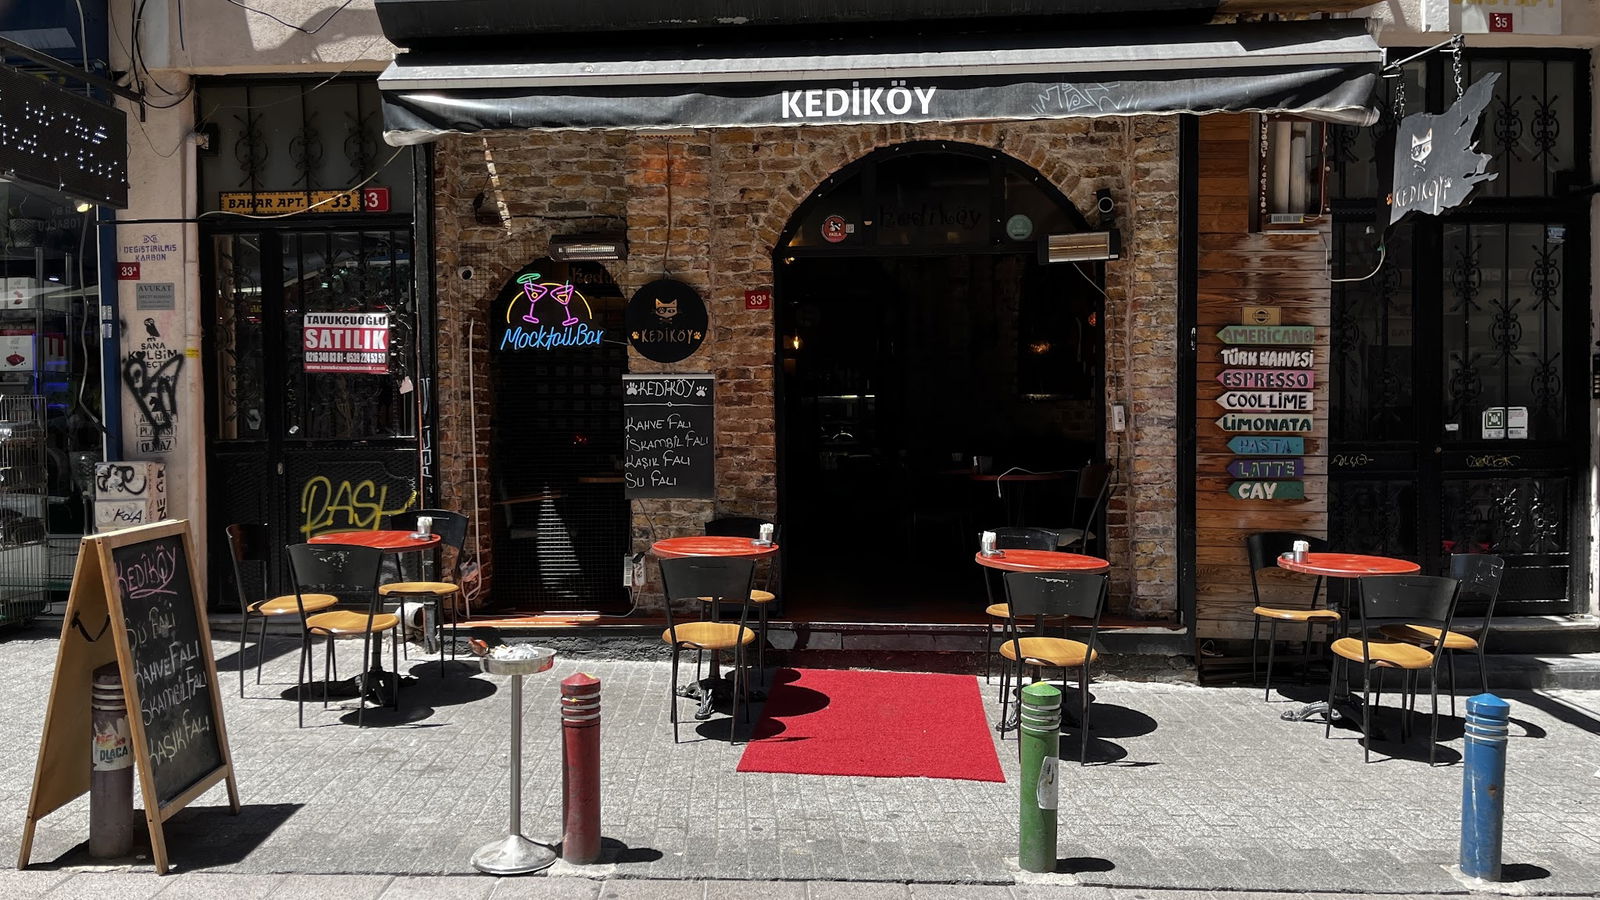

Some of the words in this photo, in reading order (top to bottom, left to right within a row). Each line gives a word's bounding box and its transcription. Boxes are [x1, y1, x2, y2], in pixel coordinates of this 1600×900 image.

[1495, 16, 1507, 28] 35
[781, 80, 937, 118] KEDİKÖY
[228, 198, 272, 209] BAHAR
[276, 197, 304, 208] APT.
[135, 253, 167, 262] KARBON
[305, 328, 386, 350] SATILIK
[500, 324, 577, 351] Mocktail
[577, 322, 604, 346] Bar
[641, 328, 694, 345] KEDİKÖY
[140, 342, 166, 351] SANA
[1220, 347, 1258, 366] TÜRK
[1223, 371, 1309, 388] ESPRESSO
[624, 416, 665, 434] KAHVE
[667, 413, 692, 430] FALI
[684, 430, 709, 448] FALI
[1240, 438, 1292, 454] PASTA
[624, 454, 660, 470] KAŞIK
[662, 449, 691, 467] FALI
[624, 472, 645, 488] SU
[650, 469, 677, 487] FALI
[1239, 461, 1295, 478] LATTE
[134, 656, 171, 689] KAHVE
